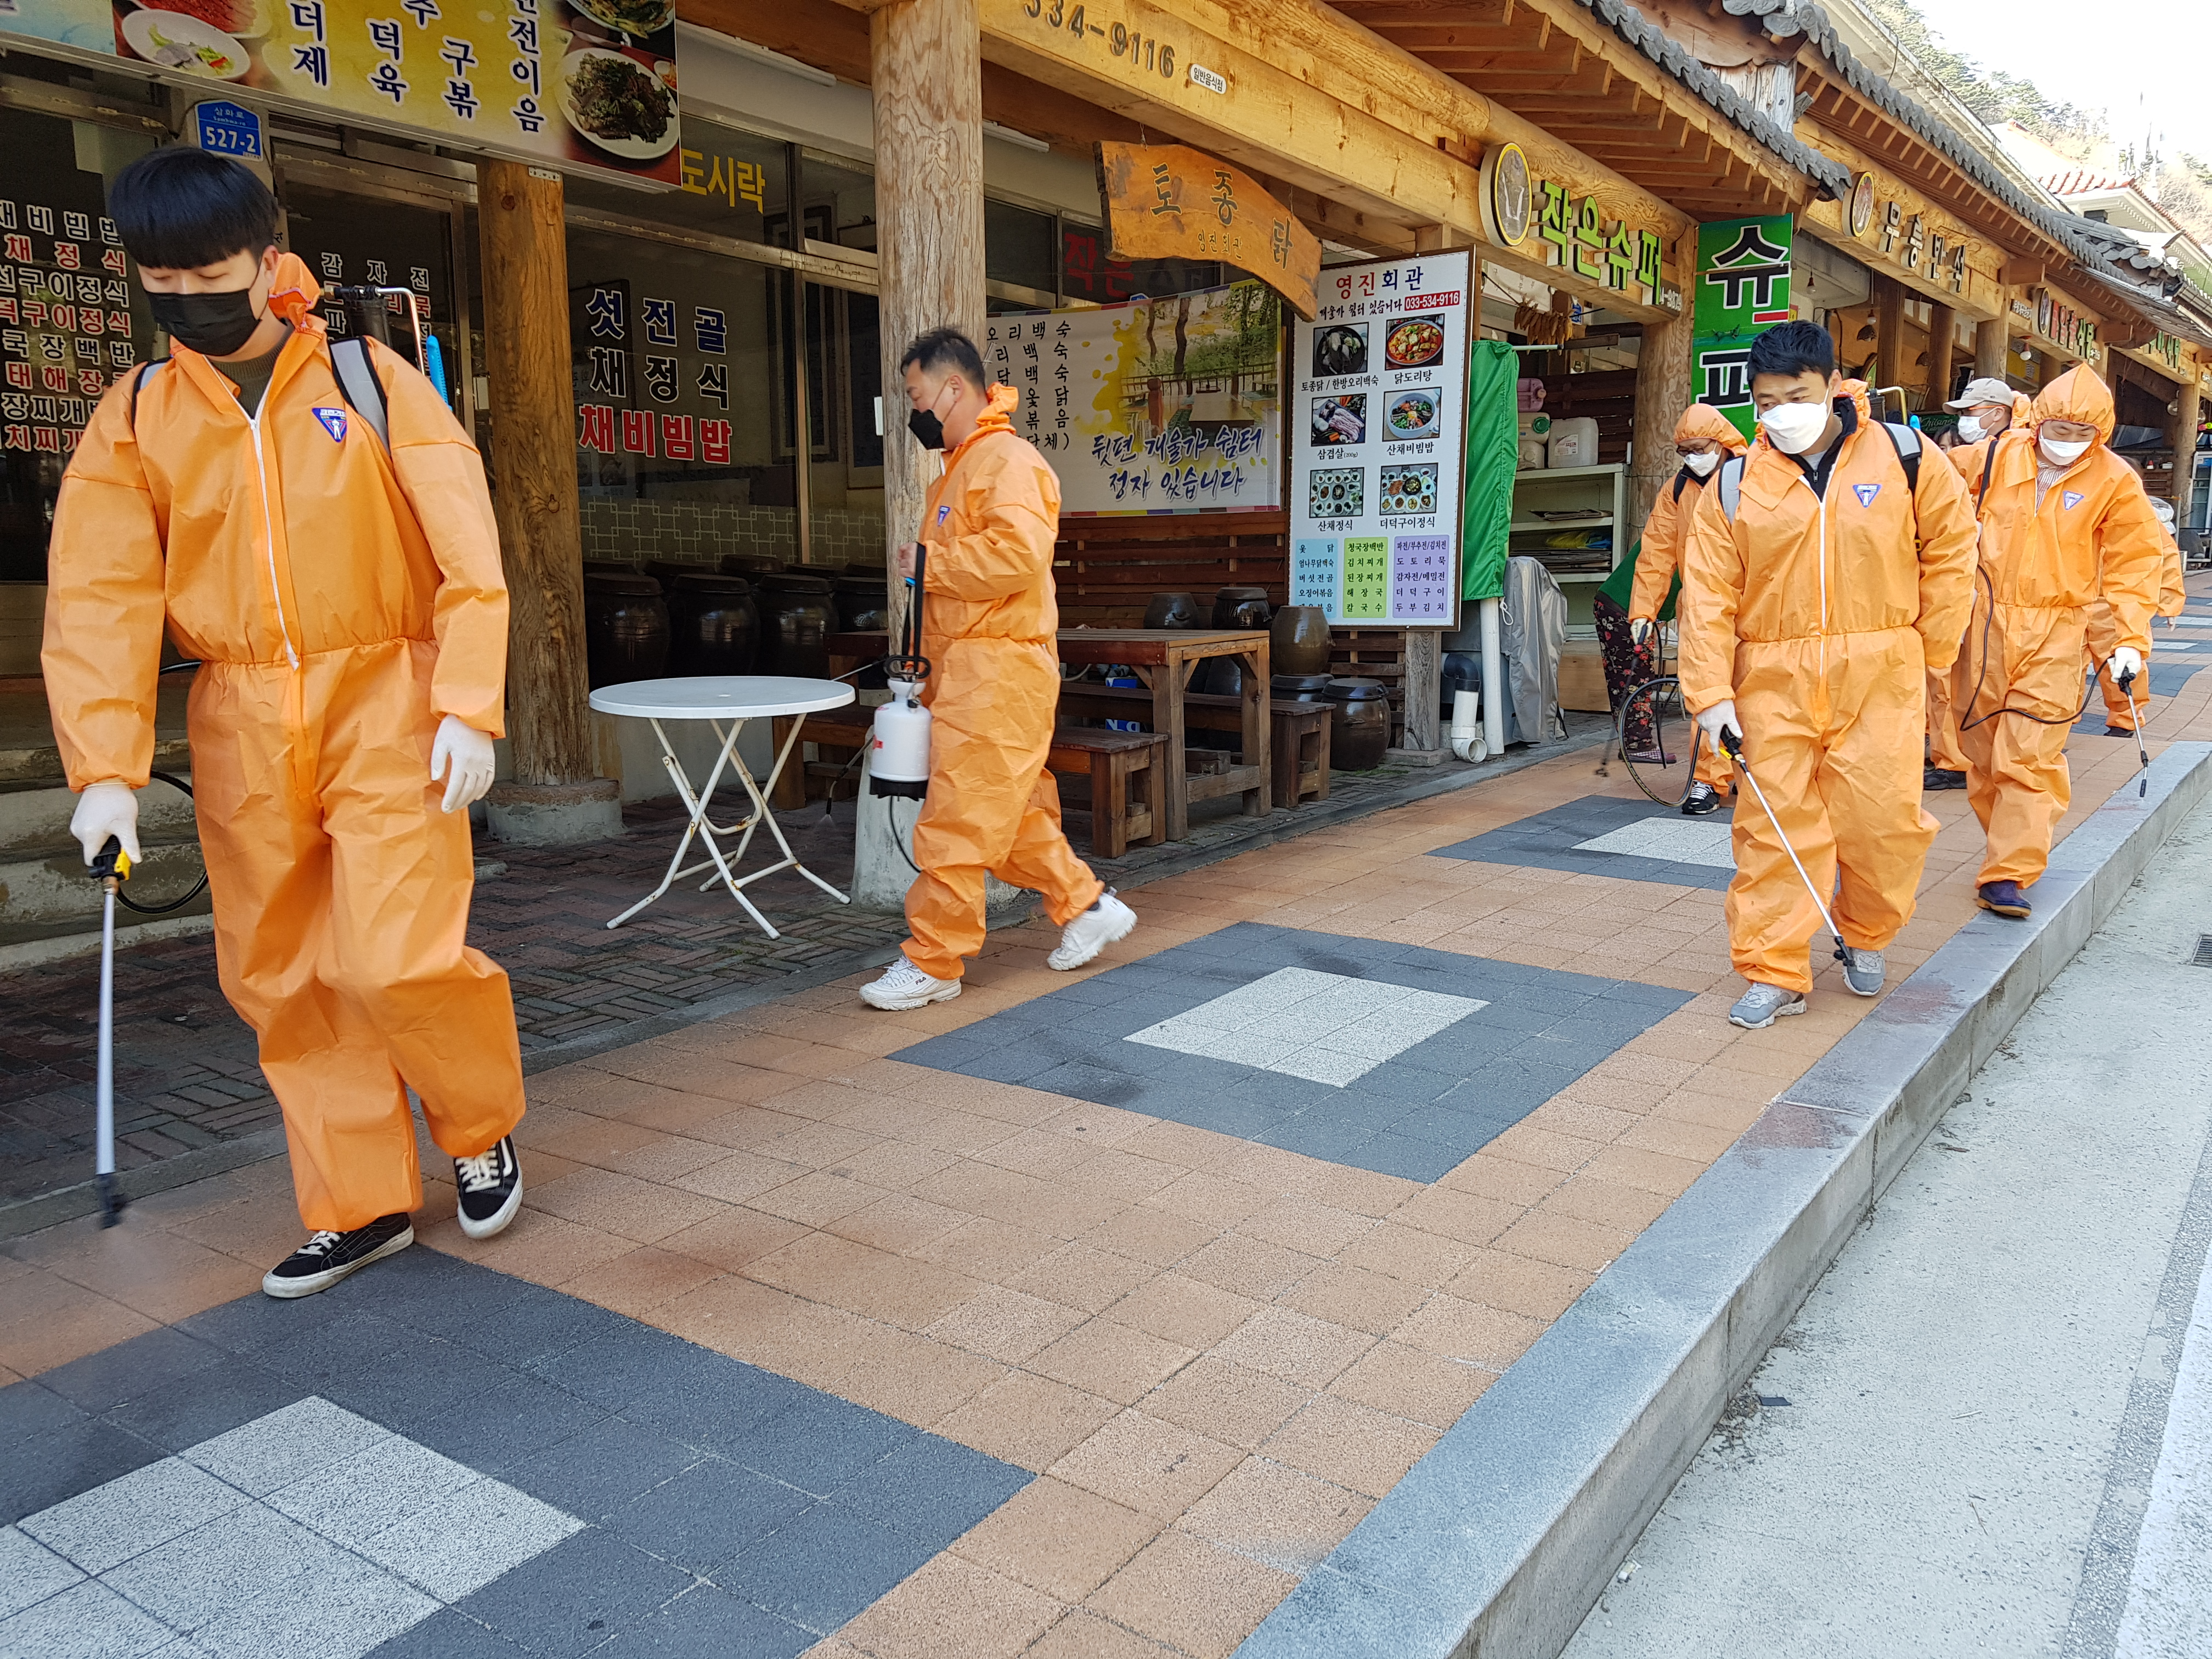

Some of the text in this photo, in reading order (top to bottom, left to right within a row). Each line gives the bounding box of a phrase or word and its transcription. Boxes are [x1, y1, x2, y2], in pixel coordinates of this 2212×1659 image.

[290, 2, 538, 95] 더덕구이
[294, 47, 545, 133] 제육볶음
[1193, 66, 1223, 92] 일반음식점
[206, 126, 256, 153] 527-2
[681, 148, 765, 214] 도시락
[1150, 162, 1293, 270] 토종닭
[4, 233, 127, 278] 채정식
[1198, 229, 1243, 260] 영진회관
[321, 252, 430, 291] 감자전
[1336, 266, 1424, 299] 영진회관
[1319, 298, 1402, 320] 개울가 쉼터 있습니다
[1406, 292, 1459, 309] 033-534-9116
[585, 288, 726, 354] 섯전골
[986, 320, 1071, 340] 오리백숙
[2, 329, 136, 368] 국장백반
[5, 360, 124, 396] 태해장
[590, 346, 729, 410] 채정식
[1301, 380, 1324, 392] 토종닭
[1332, 375, 1379, 390] 한방오리백숙
[1395, 370, 1432, 385] 닭도리탕
[578, 403, 732, 465] 채비빔밥
[1092, 426, 1262, 466] 뒷편 개울가 쉼터
[1386, 441, 1434, 456] 산채비빔밥
[1109, 466, 1246, 500] 정자 있습니다
[1317, 520, 1353, 532] 산채정식
[1380, 517, 1435, 529] 더덕구이정식
[1347, 557, 1383, 567] 김치찌개
[1396, 556, 1446, 566] 도토리묵
[1299, 573, 1334, 583] 버섯전골
[1347, 573, 1383, 582] 된장찌개
[1299, 588, 1333, 597] 오징어볶음
[1347, 588, 1383, 597] 해장국
[1396, 587, 1444, 596] 더덕구이
[1347, 603, 1383, 612] 칼국수
[1395, 602, 1444, 612] 두부김치
